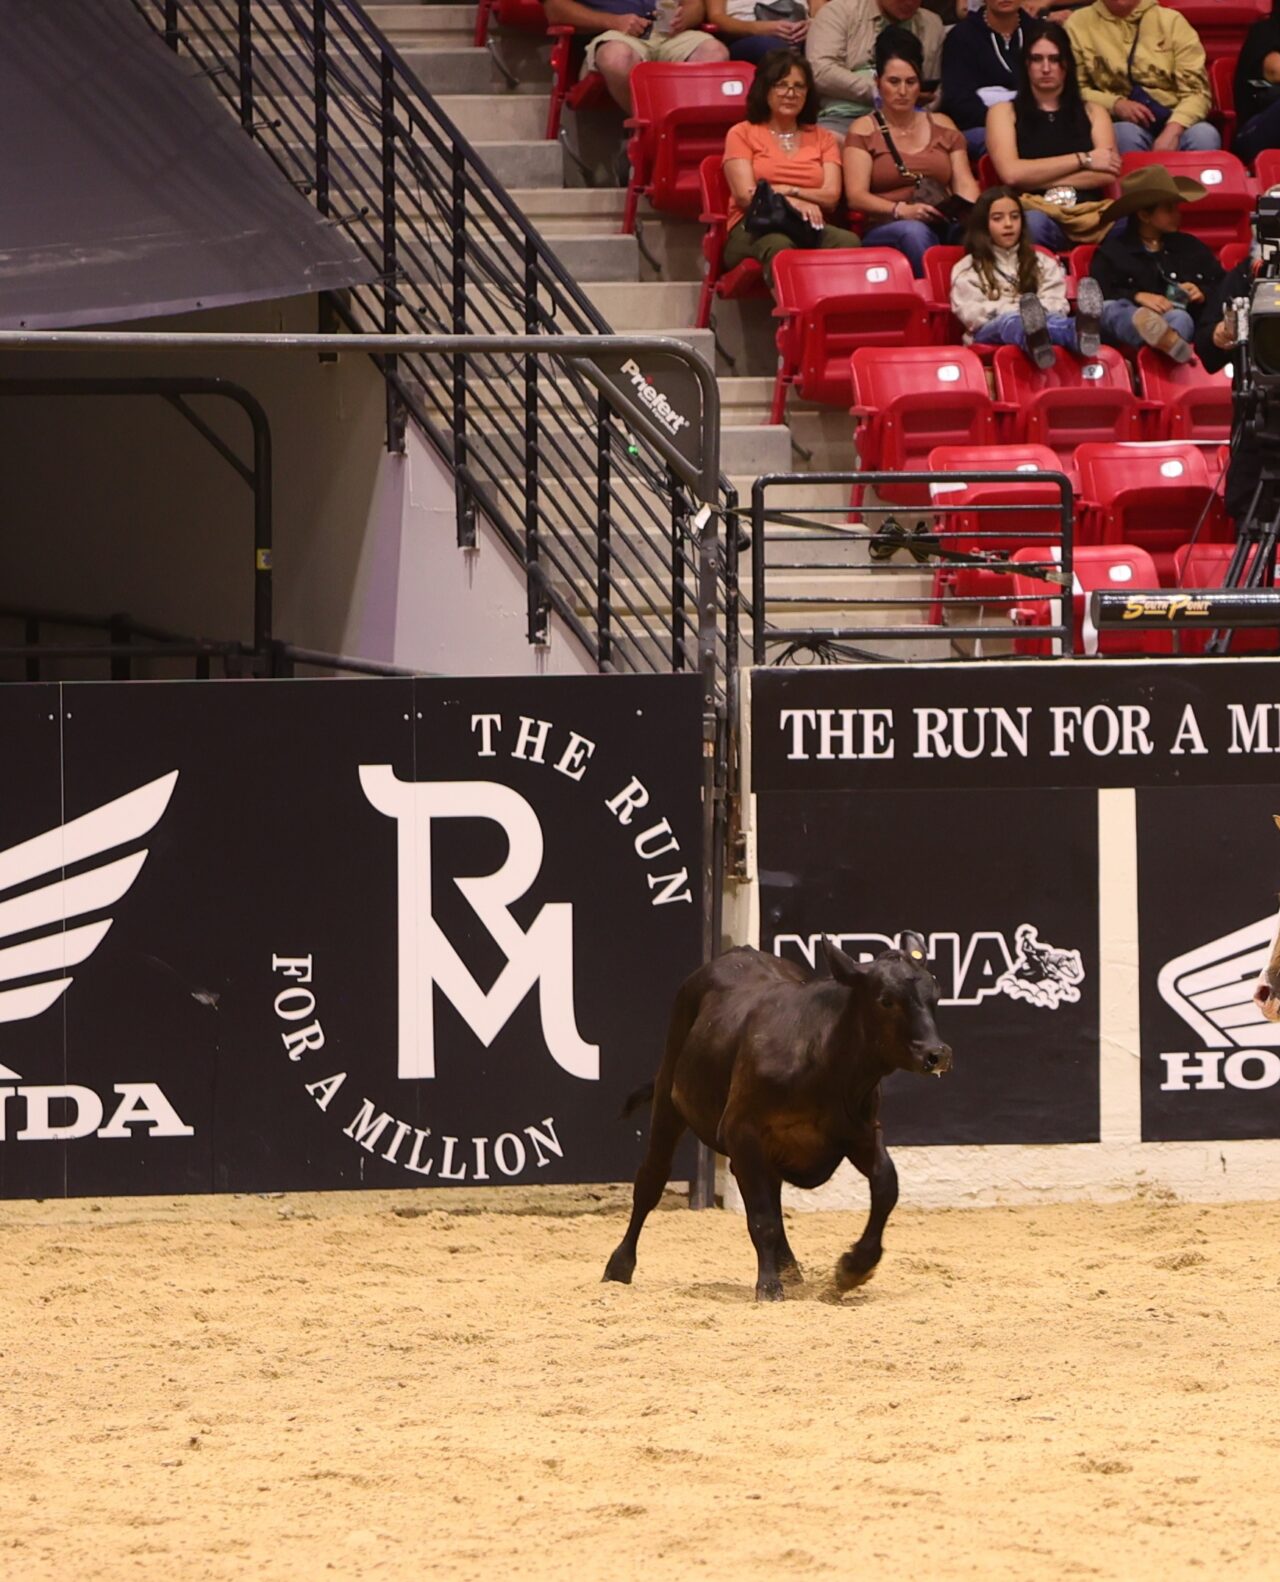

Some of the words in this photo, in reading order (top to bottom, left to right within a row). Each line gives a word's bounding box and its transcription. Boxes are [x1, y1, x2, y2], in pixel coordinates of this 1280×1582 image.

[620, 359, 685, 431] Priefert
[781, 710, 894, 758] THE
[914, 708, 1032, 758] RUN
[1050, 705, 1153, 755] FOR
[1171, 704, 1208, 753] A
[472, 715, 595, 780] THE
[606, 776, 692, 905] RUN
[273, 954, 324, 1060] FOR
[306, 1073, 346, 1111] A
[343, 1099, 563, 1180] MILLION
[0, 1084, 194, 1141] DA
